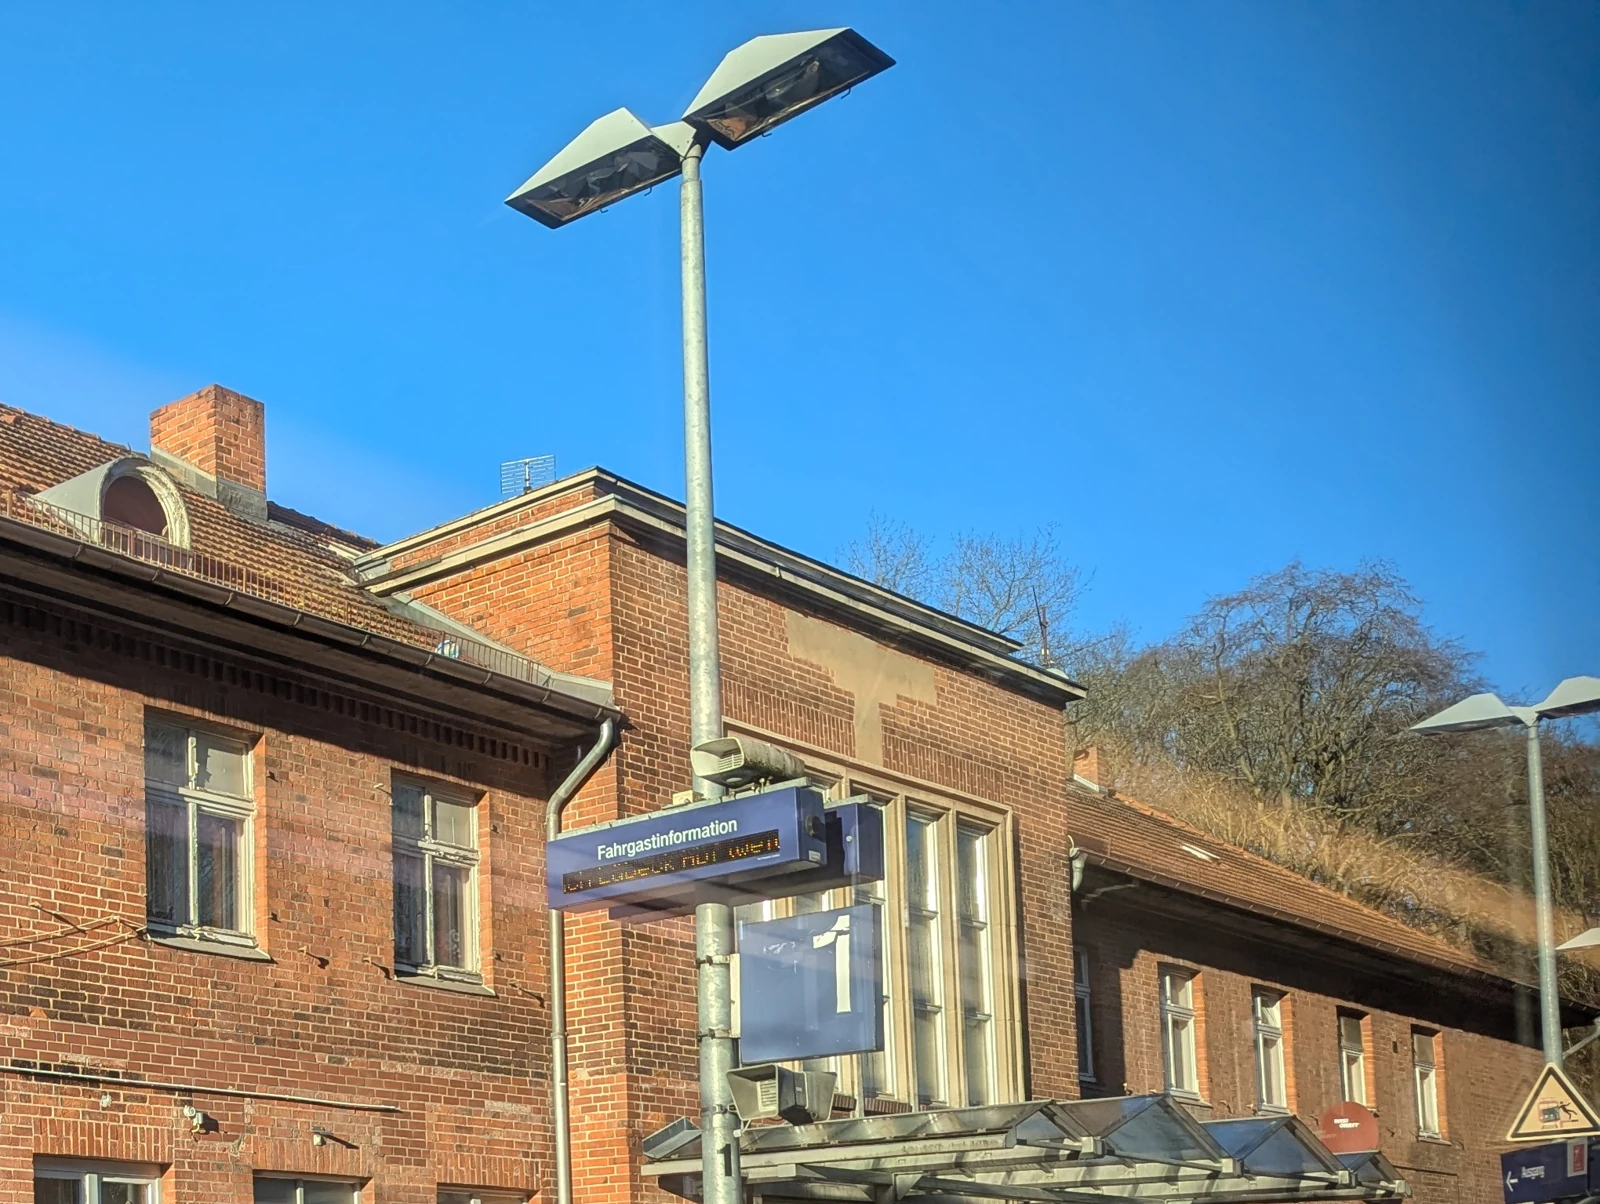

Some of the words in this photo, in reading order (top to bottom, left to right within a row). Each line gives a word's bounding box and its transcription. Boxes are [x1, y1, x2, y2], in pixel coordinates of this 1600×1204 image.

[597, 817, 738, 860] Fahrgastinformation
[812, 914, 851, 1014] 1
[716, 1143, 732, 1177] 1
